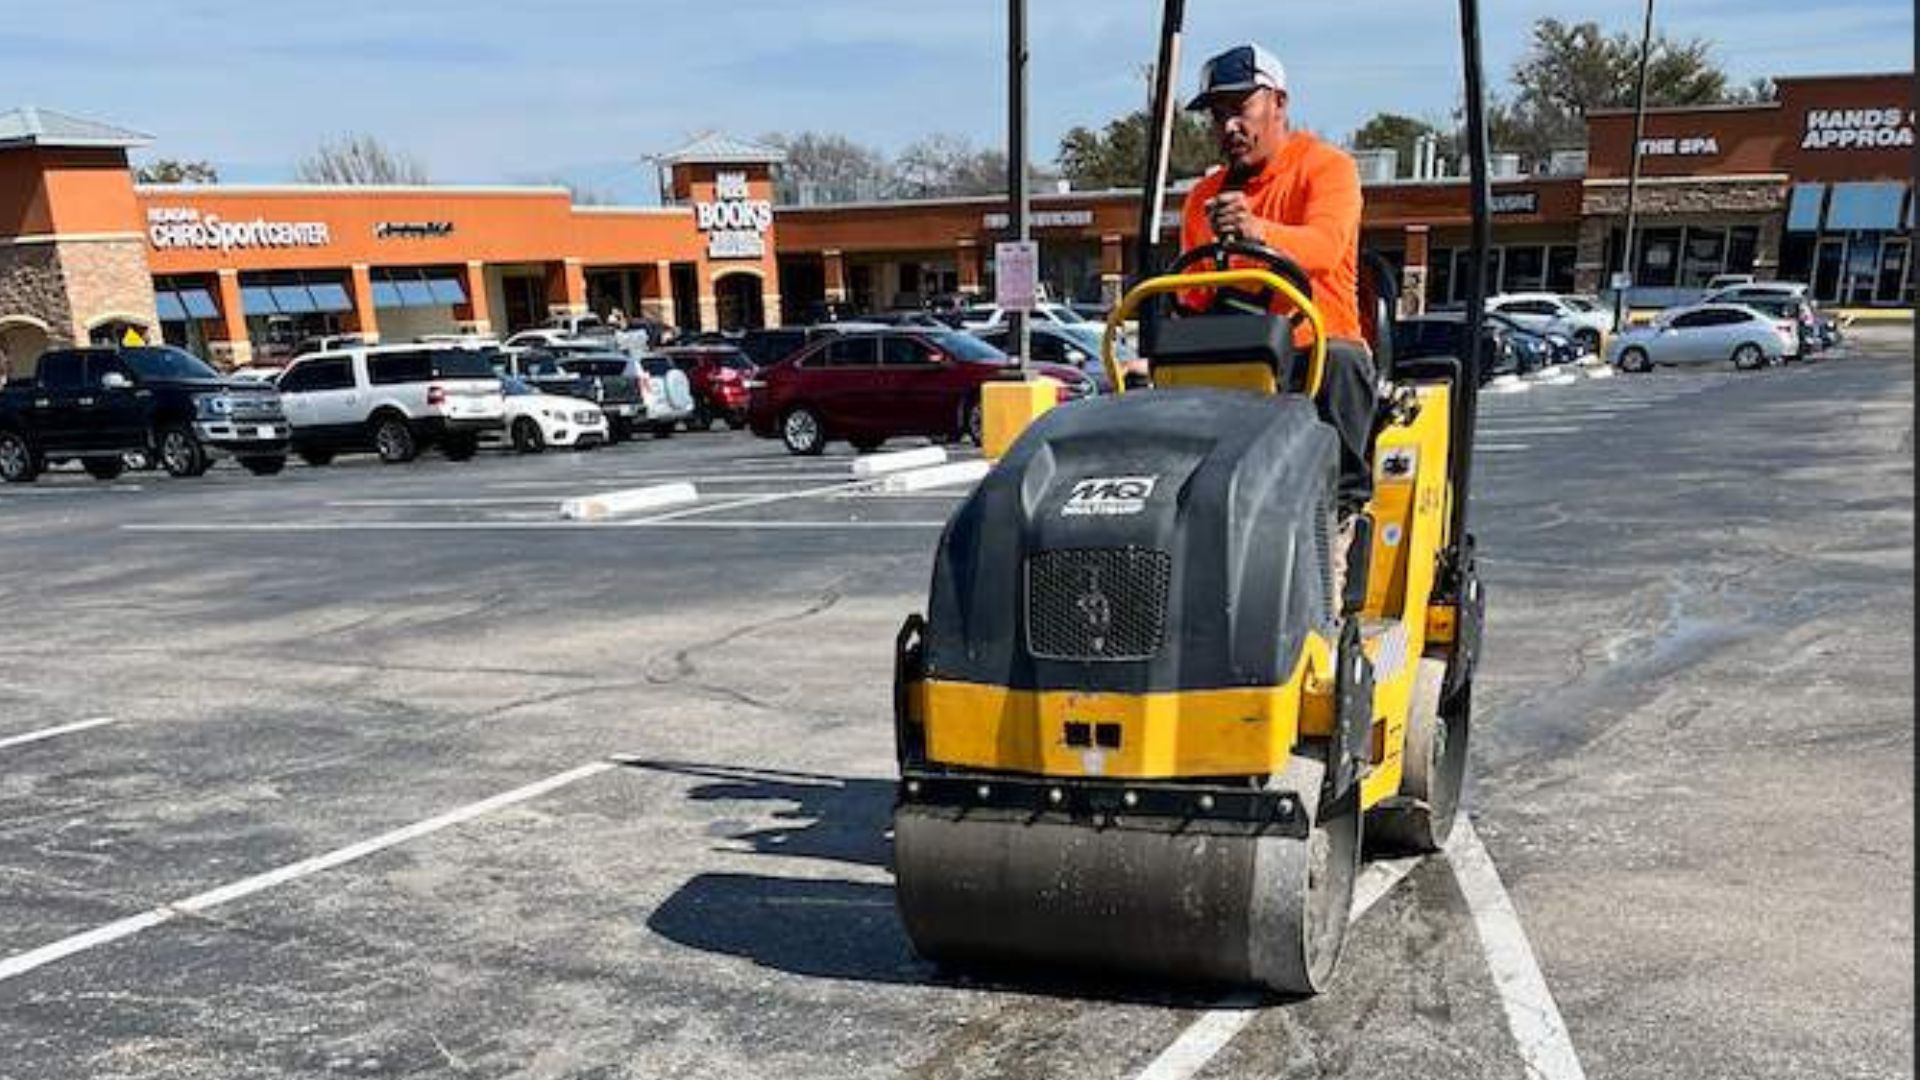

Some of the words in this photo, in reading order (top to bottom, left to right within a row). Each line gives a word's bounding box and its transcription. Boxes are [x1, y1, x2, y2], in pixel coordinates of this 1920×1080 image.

[1807, 108, 1902, 129] HANDS
[1637, 138, 1676, 155] THE
[1679, 137, 1719, 155] SPA
[1801, 127, 1914, 149] APPROA
[697, 200, 772, 231] BOOKS
